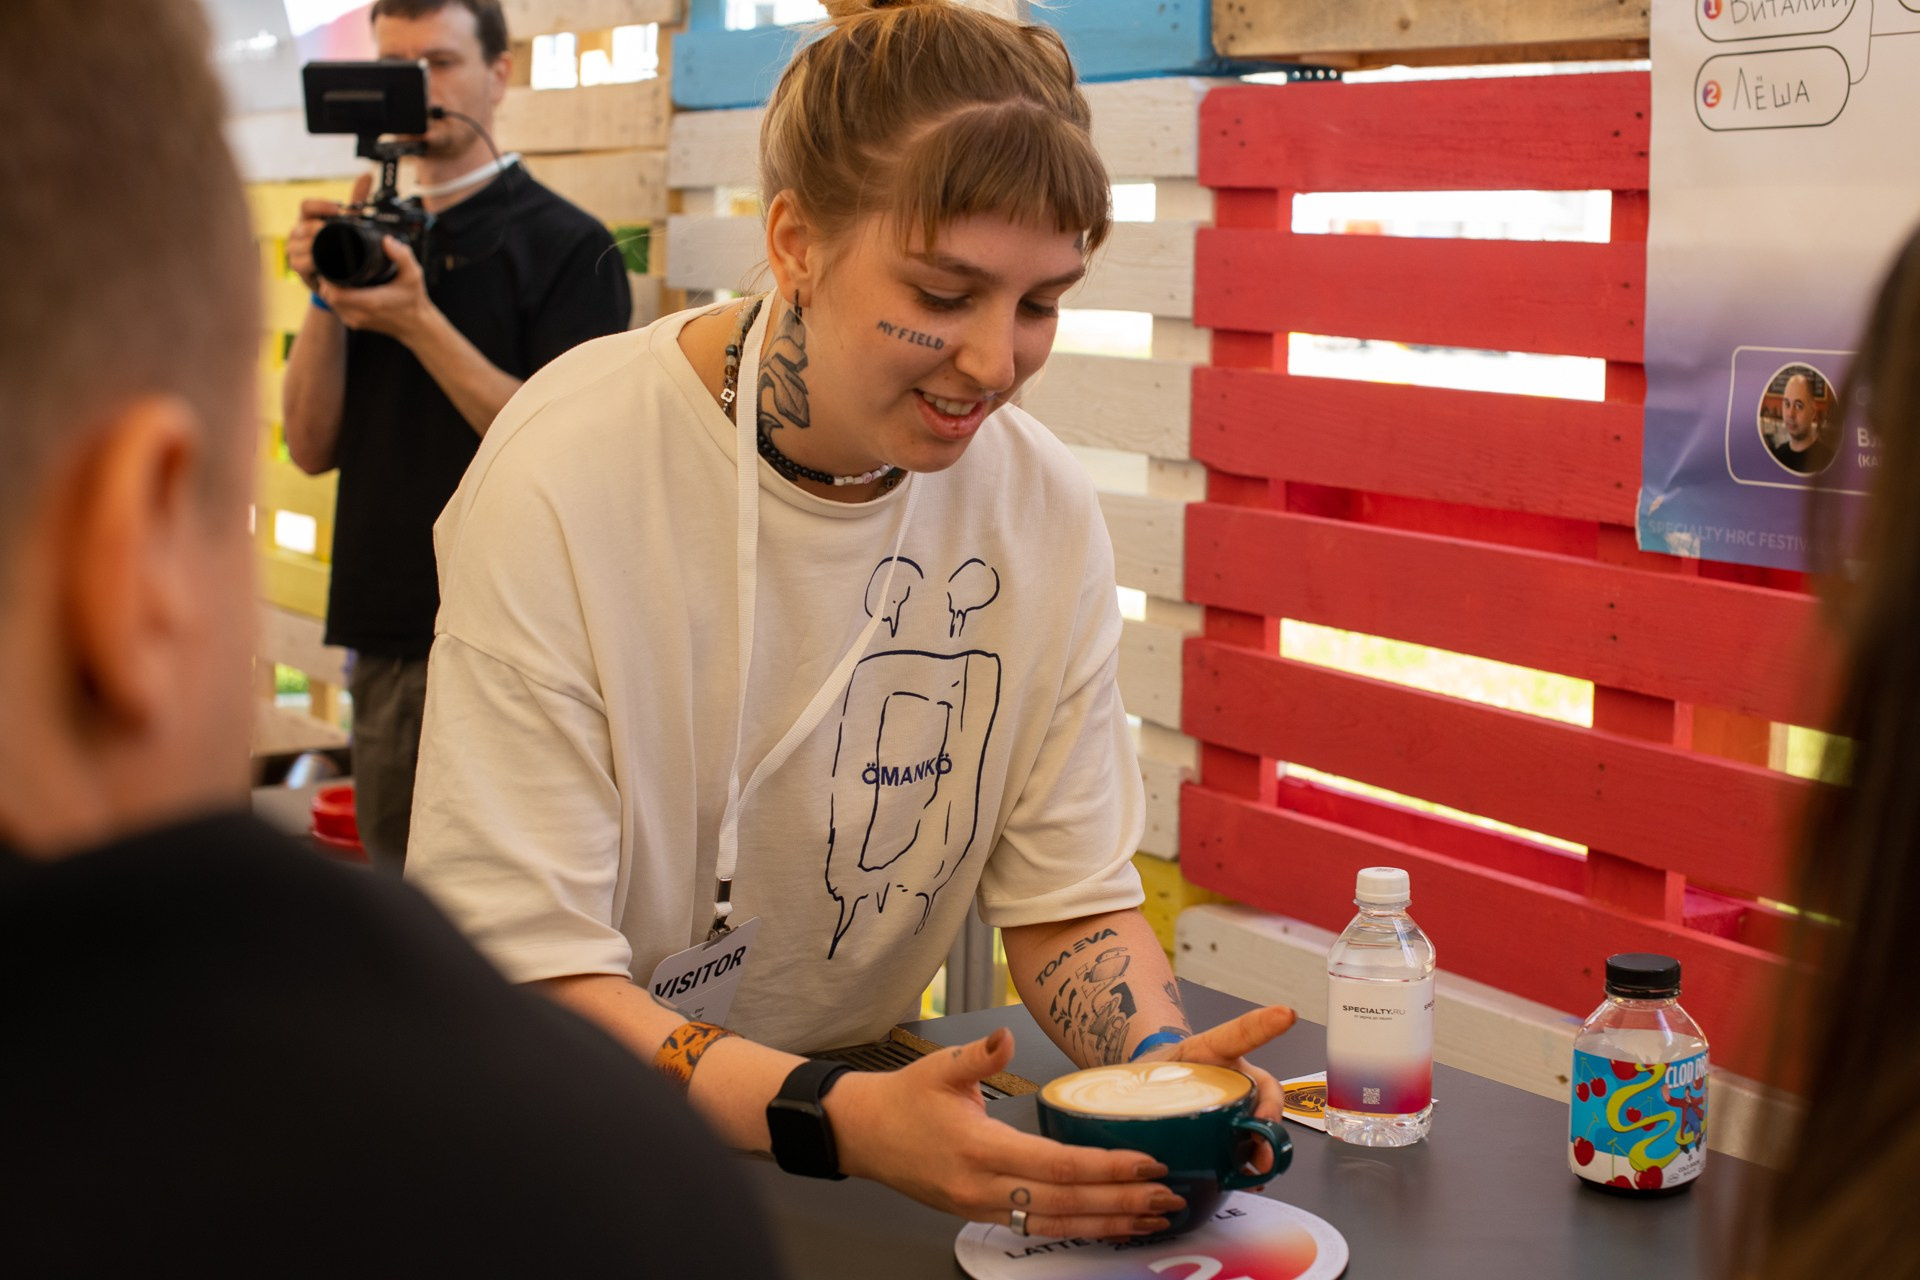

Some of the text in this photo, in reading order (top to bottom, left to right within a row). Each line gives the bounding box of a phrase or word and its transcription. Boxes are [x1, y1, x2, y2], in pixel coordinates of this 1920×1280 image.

[877, 320, 945, 350] MY FIELD
[1725, 528, 1756, 546] HRC
[862, 753, 952, 786] ÖMANKÖ
[655, 946, 746, 999] VISITOR
[1004, 1236, 1091, 1260] LATTE
